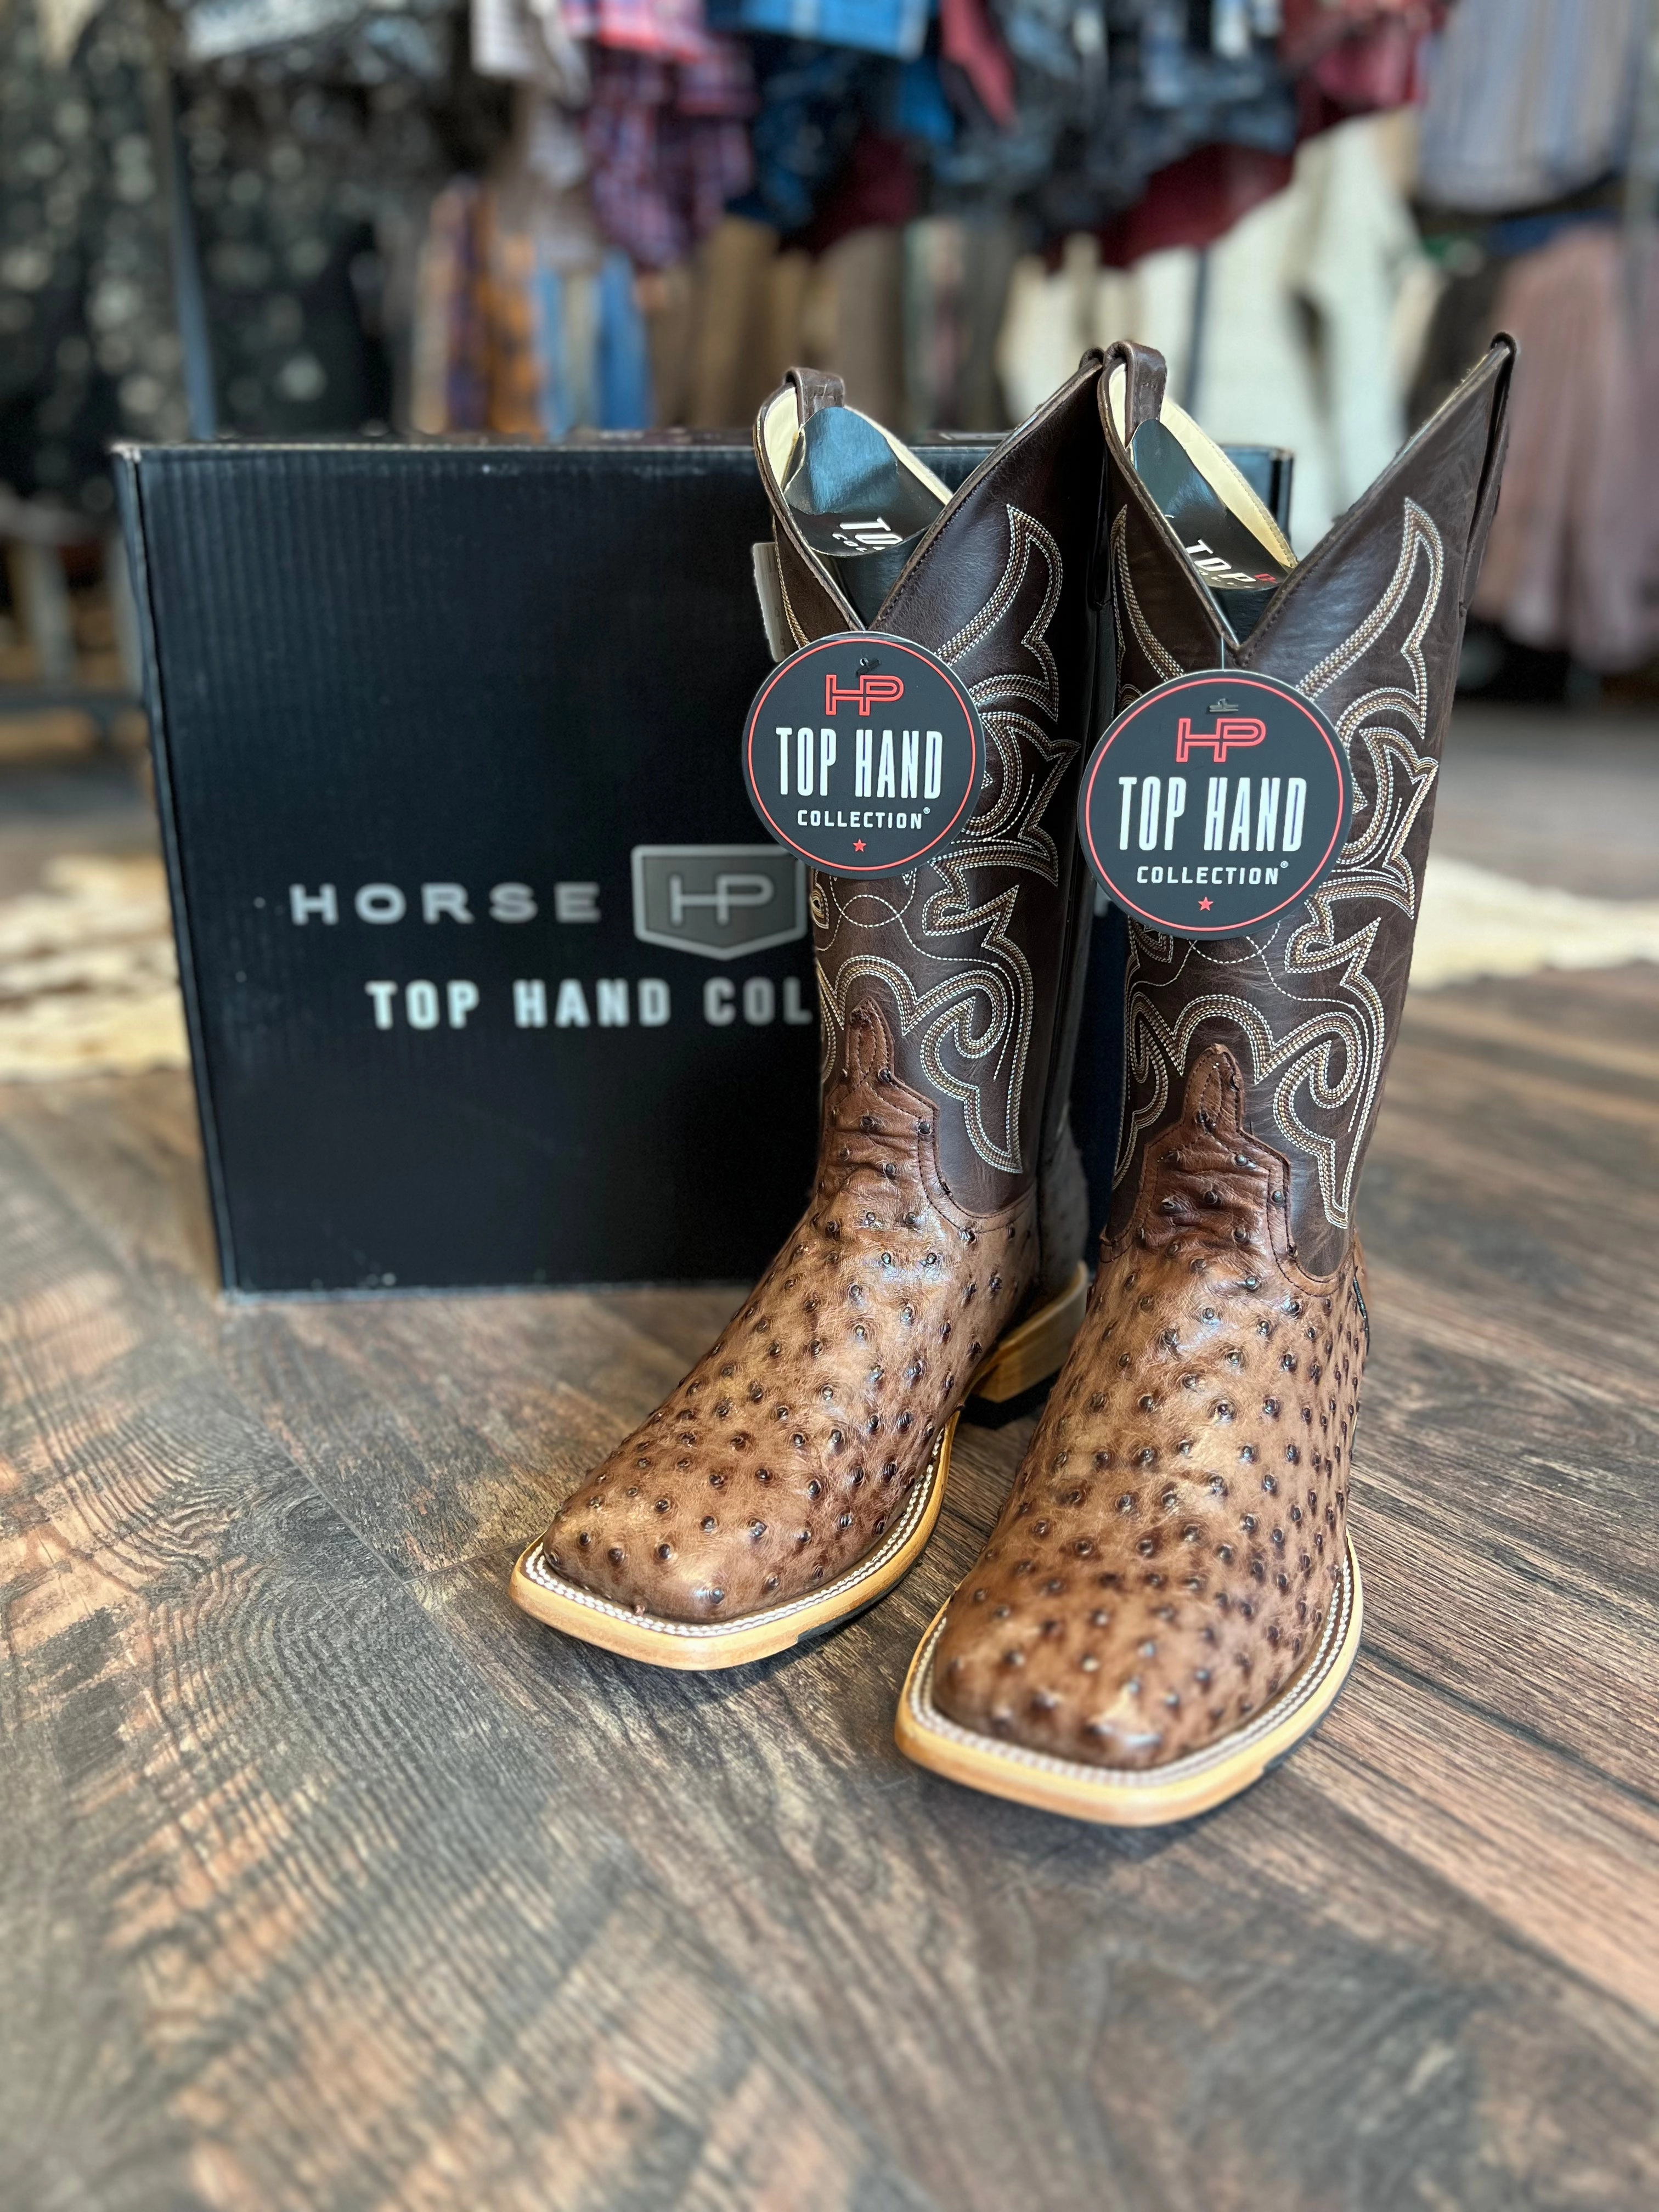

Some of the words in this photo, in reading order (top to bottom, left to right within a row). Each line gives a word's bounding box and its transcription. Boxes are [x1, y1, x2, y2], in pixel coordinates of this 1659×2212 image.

[1185, 538, 1257, 583] TOP
[825, 674, 905, 717] HP
[776, 727, 837, 797] TOP
[855, 729, 943, 800] HAND
[1175, 718, 1267, 764] HP
[1118, 776, 1187, 851] TOP
[1203, 777, 1307, 853] HAND
[289, 882, 601, 926] HORSE
[669, 874, 775, 926] HP
[365, 979, 481, 1031] TOP
[512, 979, 672, 1030] HAND
